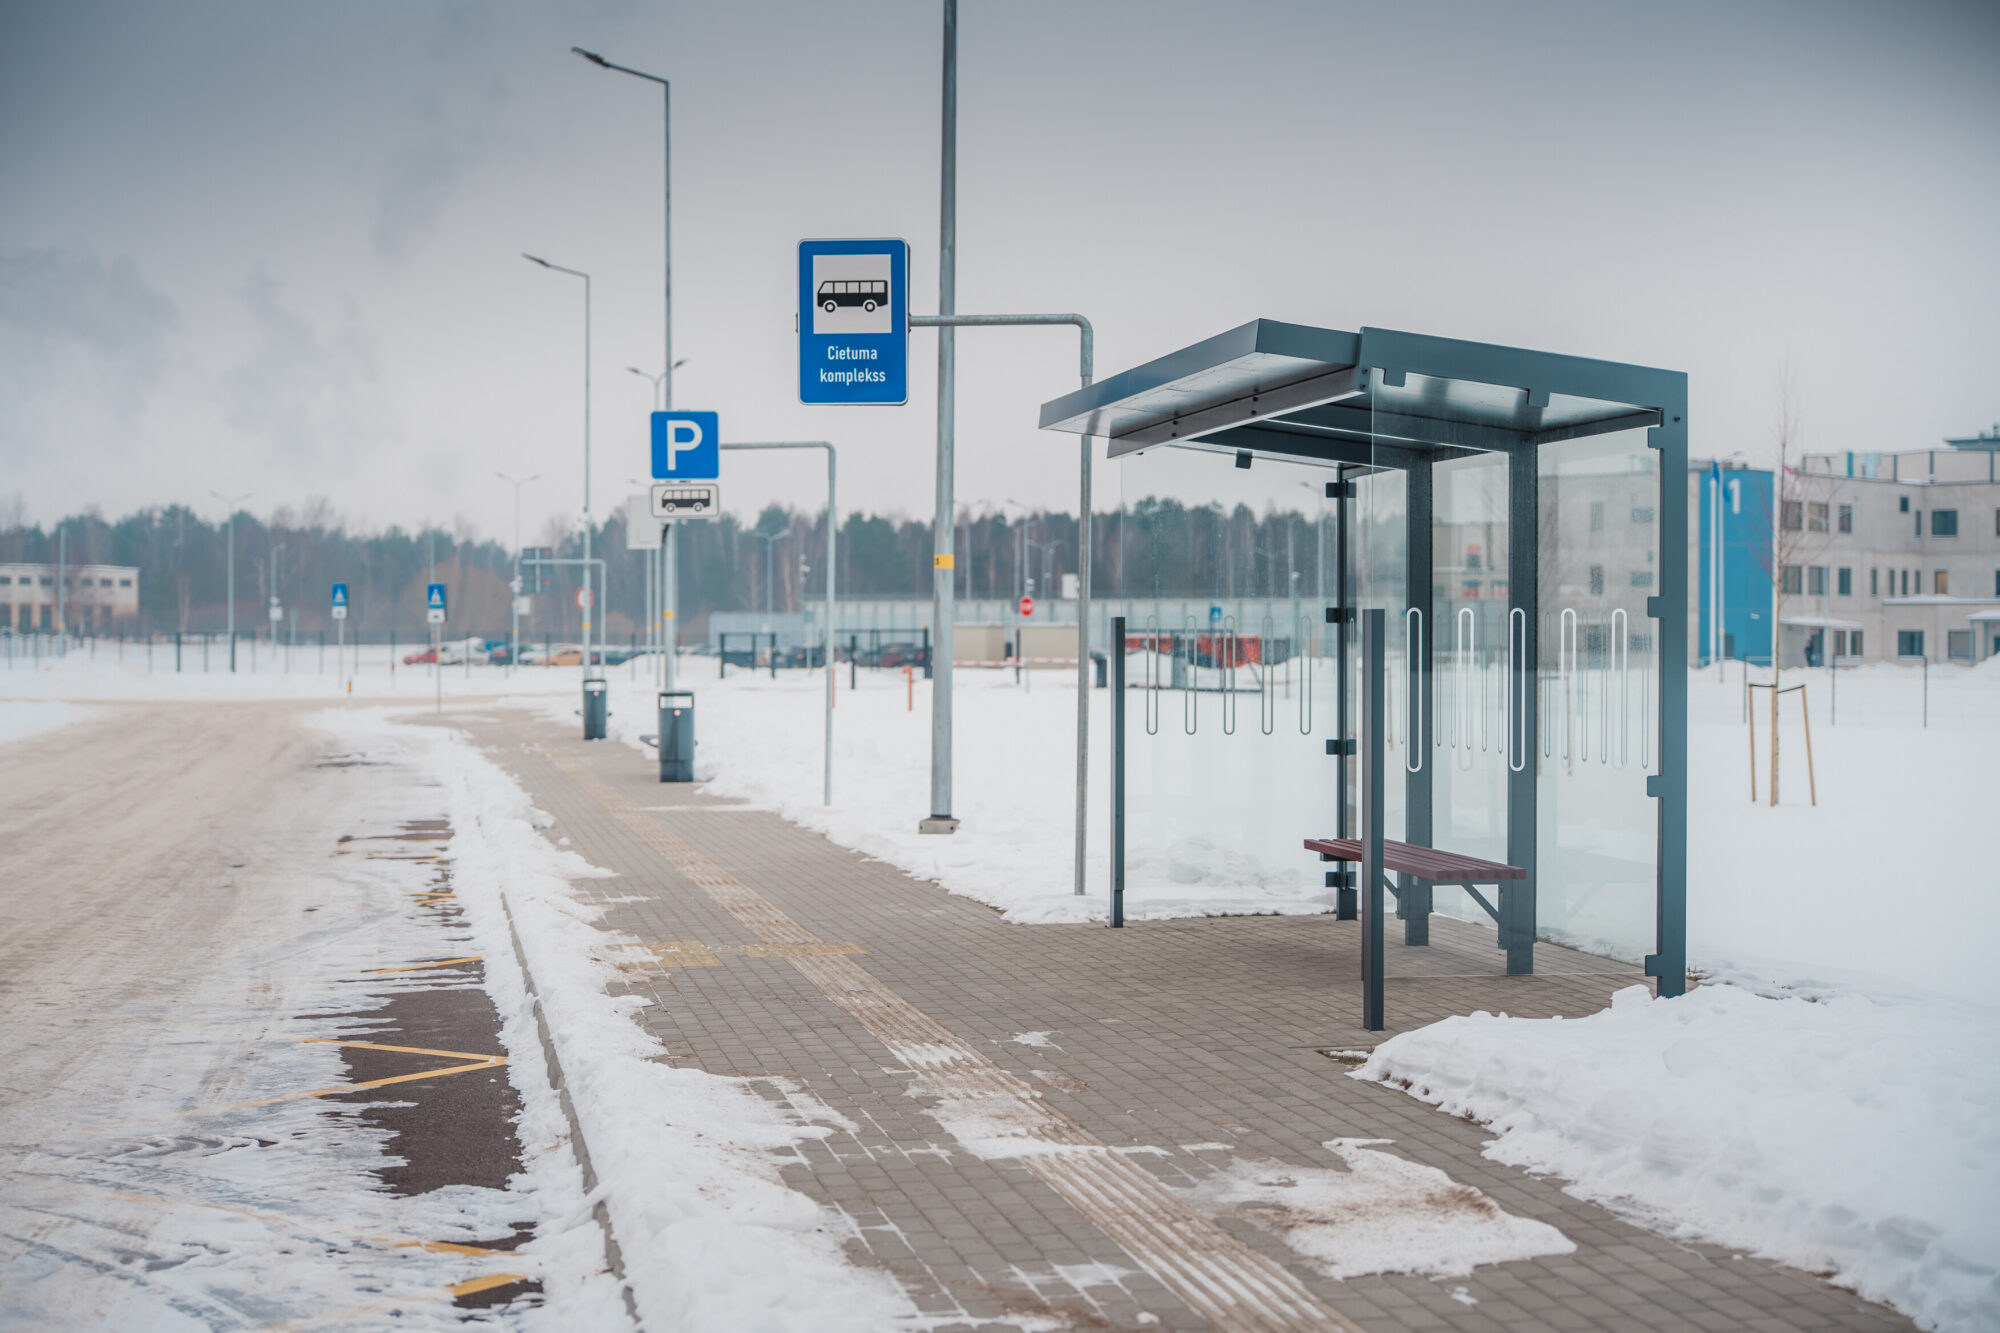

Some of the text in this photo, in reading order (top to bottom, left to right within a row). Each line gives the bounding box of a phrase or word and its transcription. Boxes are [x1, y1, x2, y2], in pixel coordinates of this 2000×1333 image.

[827, 346, 878, 360] Cietuma
[819, 368, 886, 386] komplekss
[667, 420, 703, 470] P
[1729, 478, 1741, 515] 1
